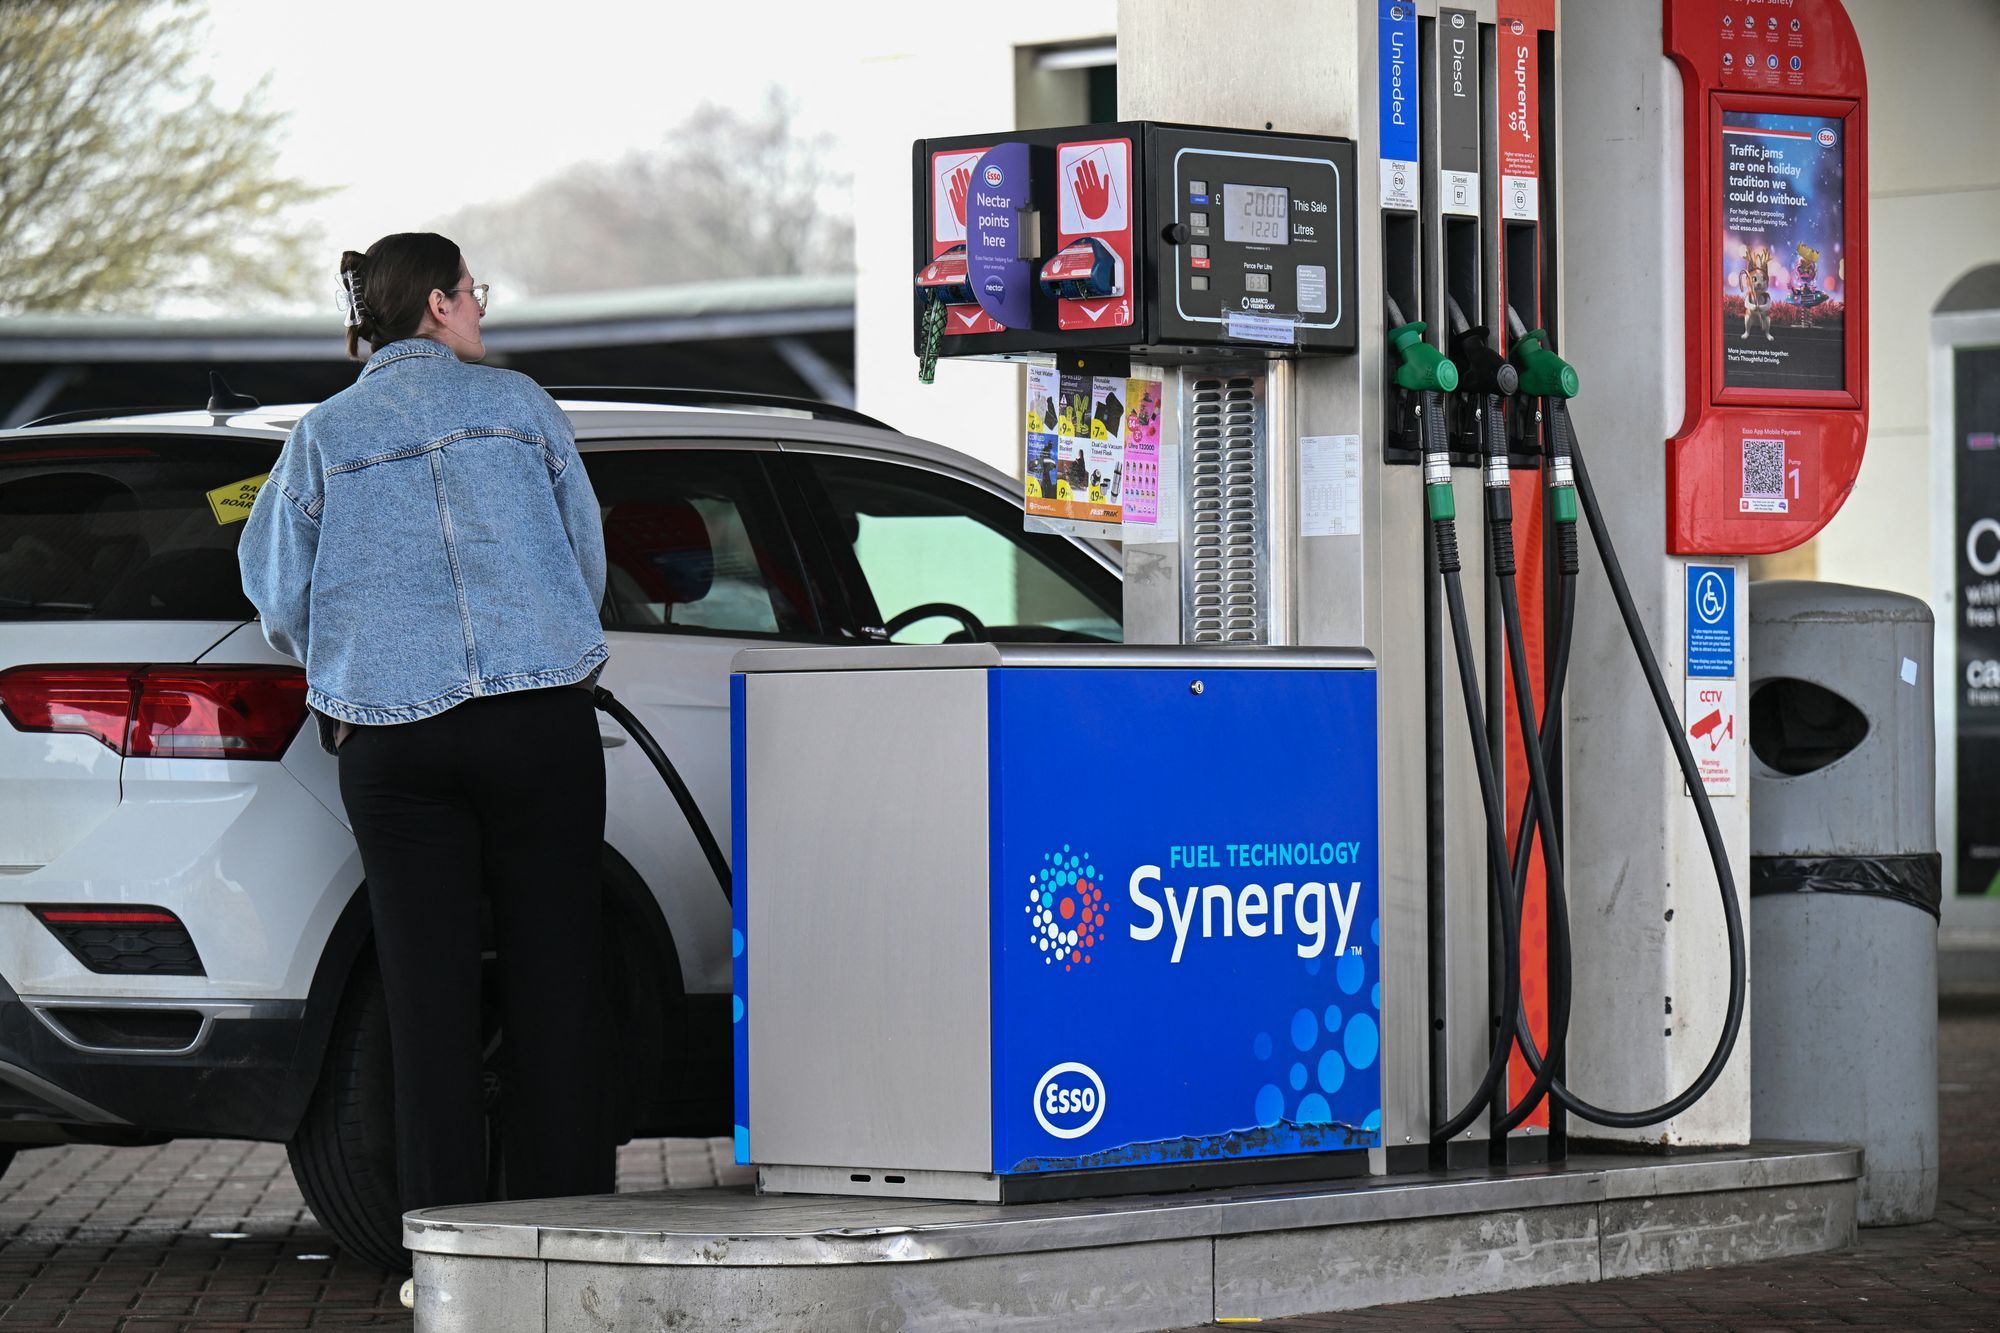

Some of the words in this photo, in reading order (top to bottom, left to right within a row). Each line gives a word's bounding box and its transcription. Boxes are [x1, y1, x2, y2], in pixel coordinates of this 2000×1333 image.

[1453, 39, 1466, 98] Diesel
[1392, 32, 1405, 126] Unleaded
[1508, 112, 1518, 131] 99
[1820, 132, 1834, 142] Esso
[1729, 144, 1760, 157] Traffic
[1761, 146, 1784, 160] jams
[1392, 162, 1406, 170] Petrol
[1729, 162, 1745, 171] are
[1747, 163, 1765, 173] one
[1767, 162, 1801, 178] holiday
[987, 171, 1000, 180] Esso
[1394, 177, 1403, 185] E10
[1452, 176, 1468, 184] Diesel
[1729, 175, 1769, 188] tradition
[1772, 180, 1786, 189] we
[1513, 180, 1527, 189] Petrol
[977, 192, 1010, 208] Nectar
[1215, 194, 1221, 205] £
[1456, 191, 1464, 199] B7
[1516, 196, 1524, 204] E5
[1729, 190, 1754, 202] could
[1756, 192, 1769, 203] do
[1770, 192, 1808, 206] without.
[1244, 192, 1287, 218] 20.00
[1293, 200, 1309, 212] This
[1311, 201, 1327, 213] Sale
[1760, 210, 1785, 218] carpooling
[979, 213, 1009, 230] points
[1251, 221, 1279, 238] 12.20
[1293, 224, 1314, 236] Litres
[983, 232, 1005, 247] here
[1739, 348, 1758, 356] journeys
[240, 484, 261, 493] BA
[1789, 468, 1799, 499] 1
[220, 499, 253, 509] BOAR
[1700, 690, 1722, 702] CCTV
[1171, 845, 1220, 868] FUEL
[1226, 842, 1361, 866] TECHNOLOGY
[1129, 864, 1361, 964] Synergy
[1046, 1083, 1095, 1115] Esso
